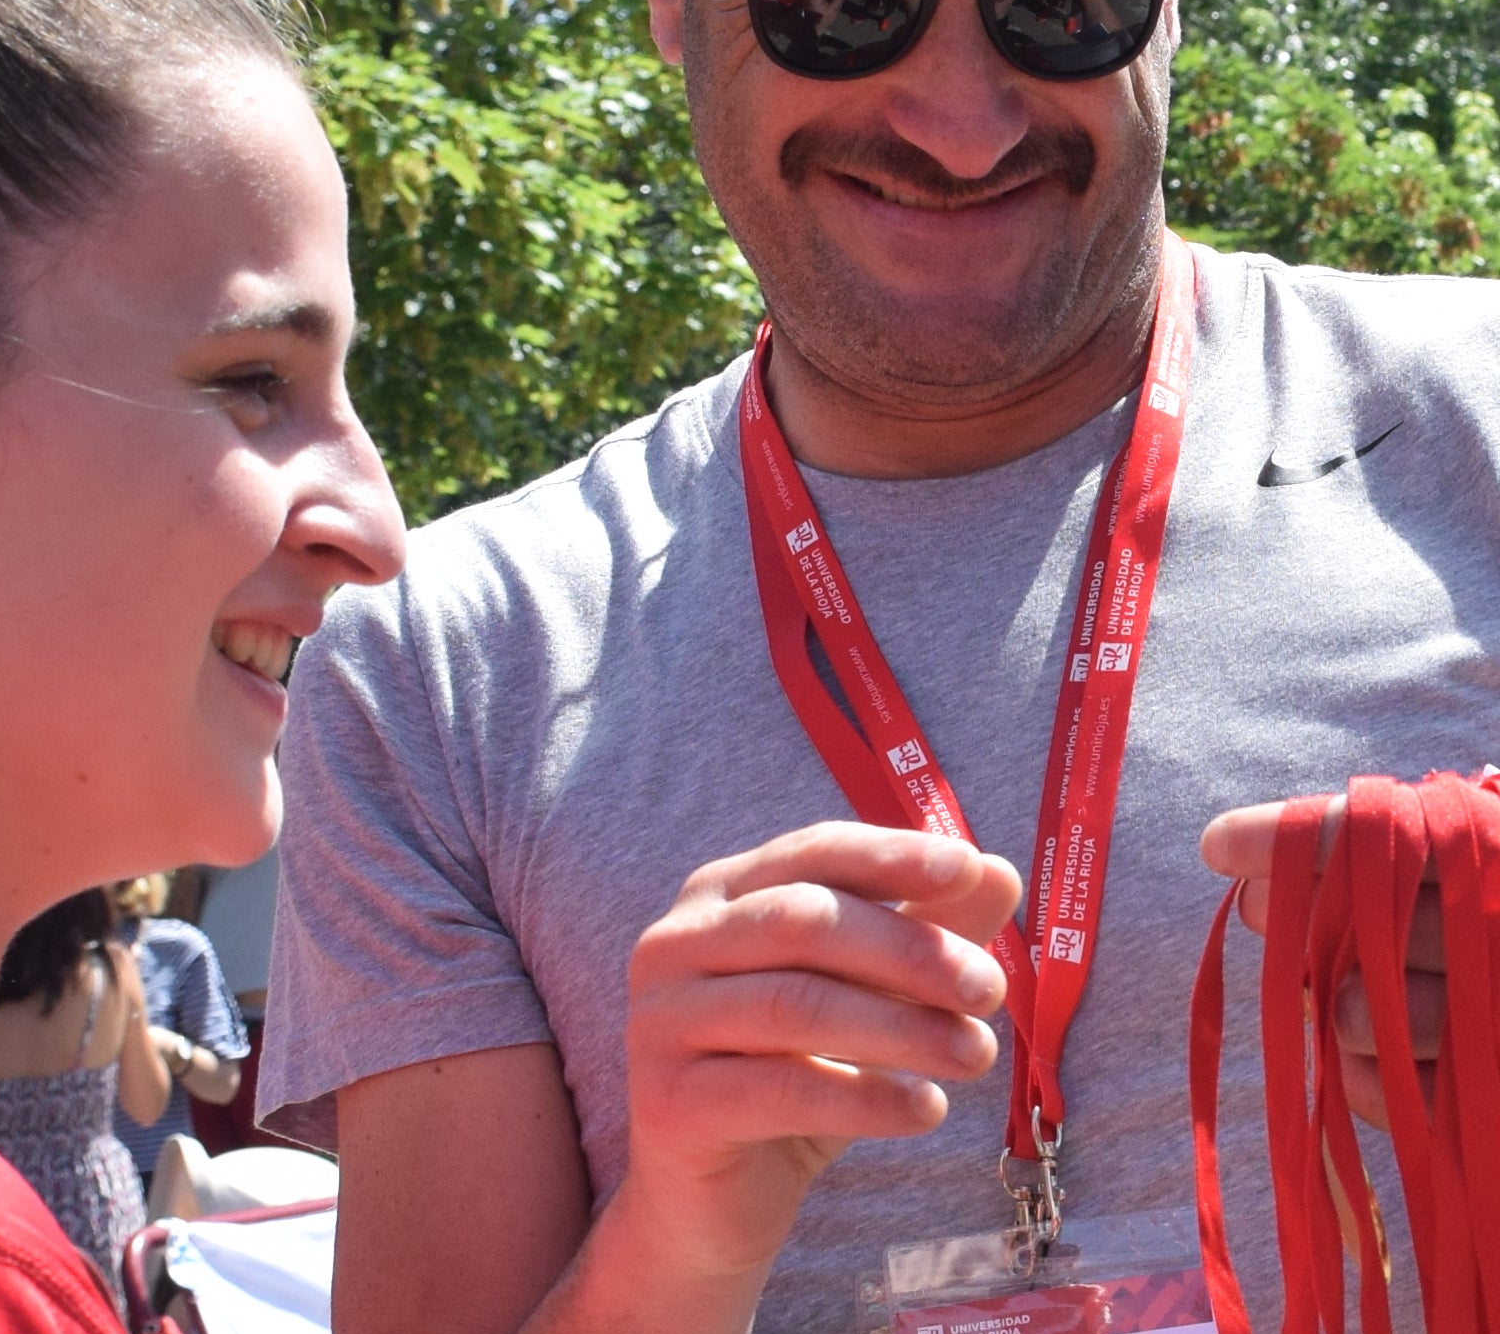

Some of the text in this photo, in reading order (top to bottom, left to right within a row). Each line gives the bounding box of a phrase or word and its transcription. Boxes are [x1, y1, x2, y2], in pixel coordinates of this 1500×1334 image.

[799, 555, 833, 619] DE LA RIOJA
[811, 548, 852, 625] UNIVERSIDAD
[1080, 561, 1105, 646] UNIVERSIDAD
[1107, 548, 1132, 635] UNIVERSIDAD
[1121, 562, 1145, 636] DE LA RIOJA
[849, 646, 893, 724] www.unirioja.es
[1085, 697, 1111, 797] www.unirioja.es
[906, 779, 946, 837] DE LA RIO
[920, 773, 961, 840] UNIVERSID
[1058, 825, 1082, 918] UNIVERSIDAD
[1073, 838, 1096, 921] DE LA RIOJA
[950, 1314, 1030, 1334] UNIVERSIDAD
